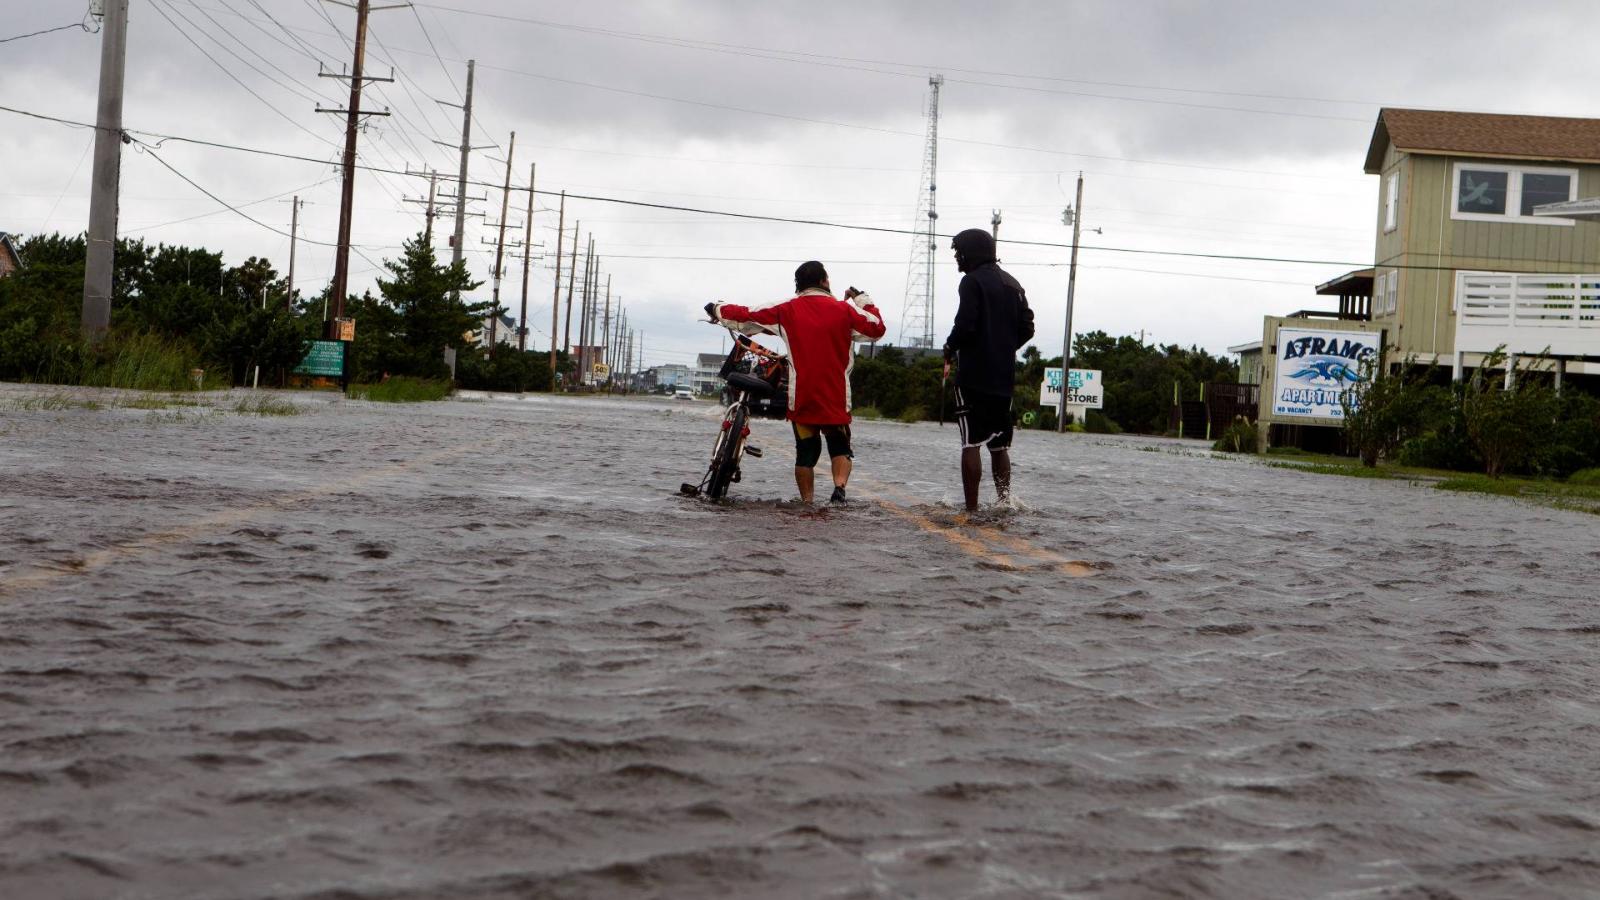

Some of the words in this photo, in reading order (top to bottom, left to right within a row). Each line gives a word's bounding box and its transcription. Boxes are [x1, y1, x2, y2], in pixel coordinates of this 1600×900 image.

[1051, 378, 1084, 387] DIHES
[1047, 385, 1079, 394] THFT
[1067, 395, 1098, 403] STORE
[1282, 388, 1361, 407] APARTMET
[1287, 406, 1312, 414] VACANCY
